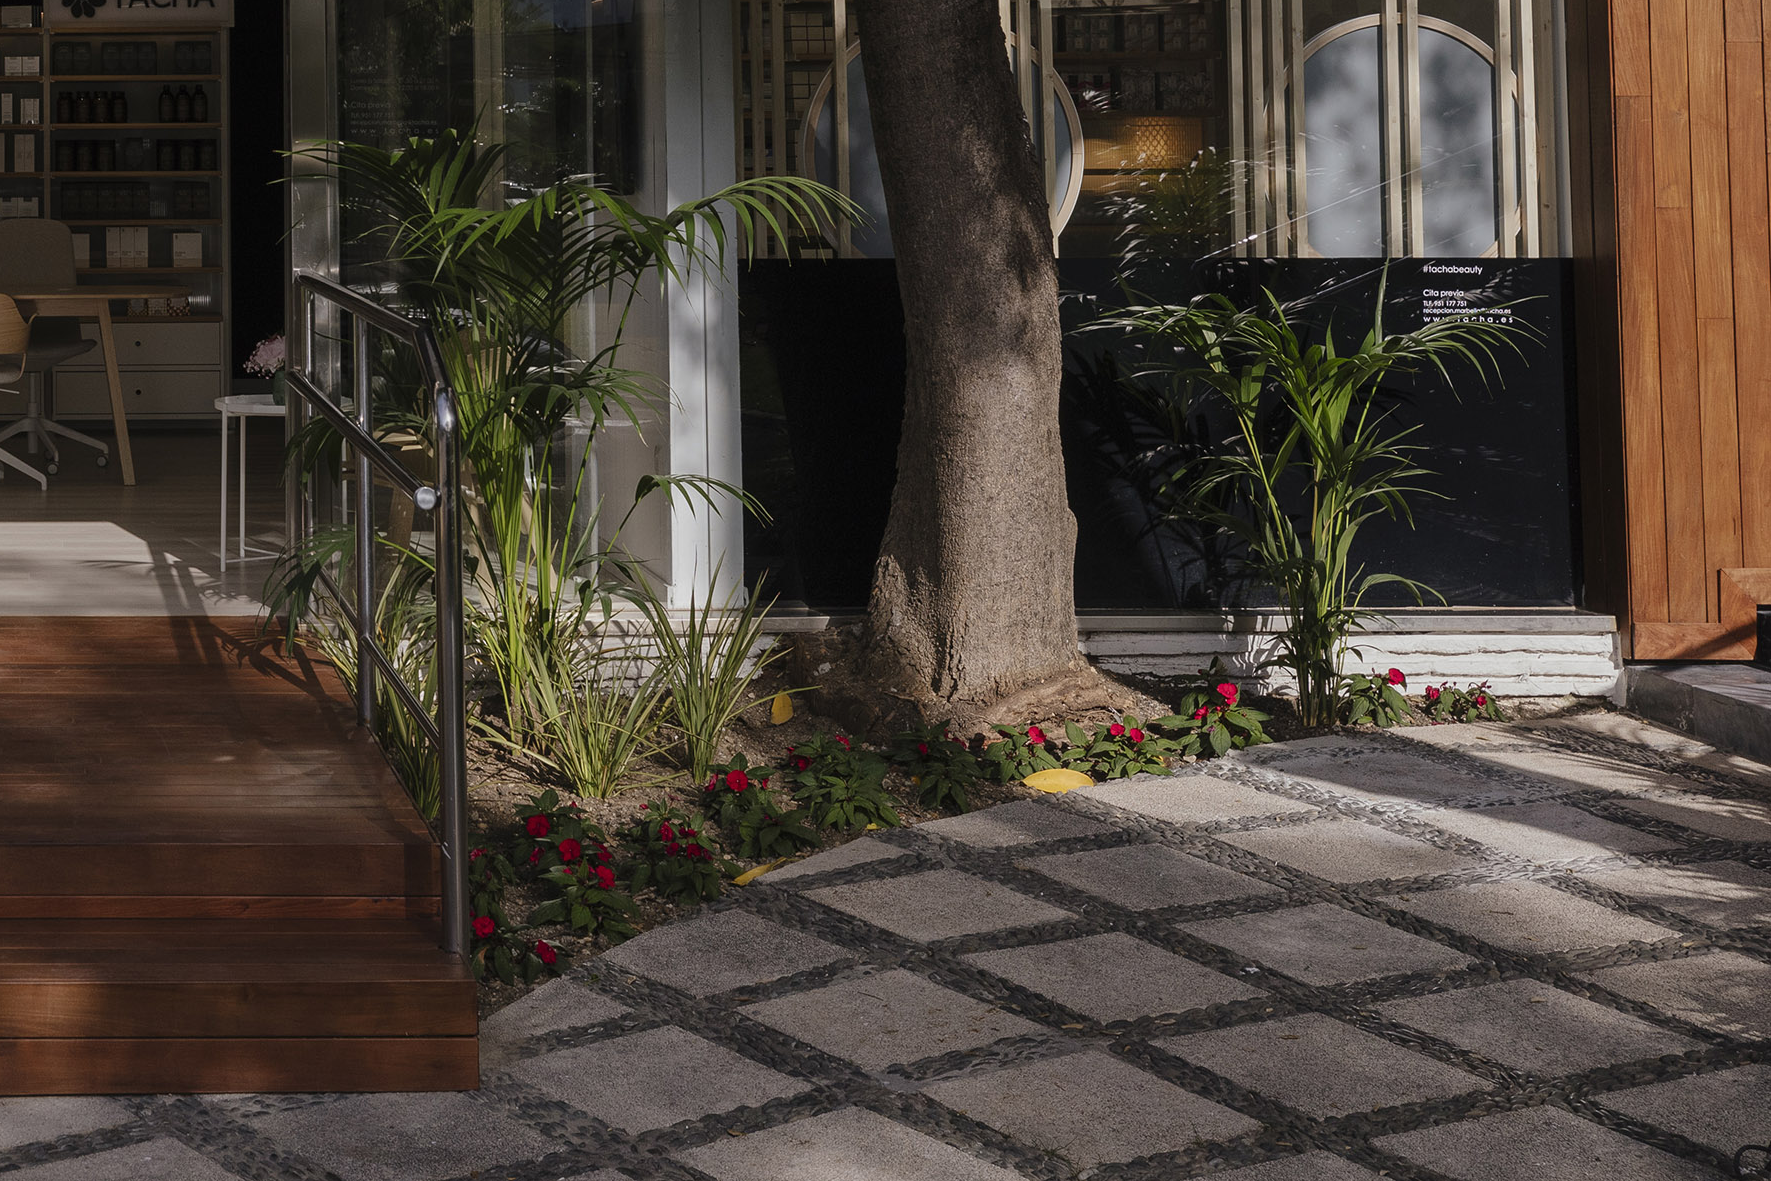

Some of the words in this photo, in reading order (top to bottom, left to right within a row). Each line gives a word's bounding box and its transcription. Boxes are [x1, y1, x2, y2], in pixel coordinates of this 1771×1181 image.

[1423, 265, 1483, 275] #tachabeauty
[1423, 289, 1439, 297] Cita
[1440, 289, 1464, 298] previa
